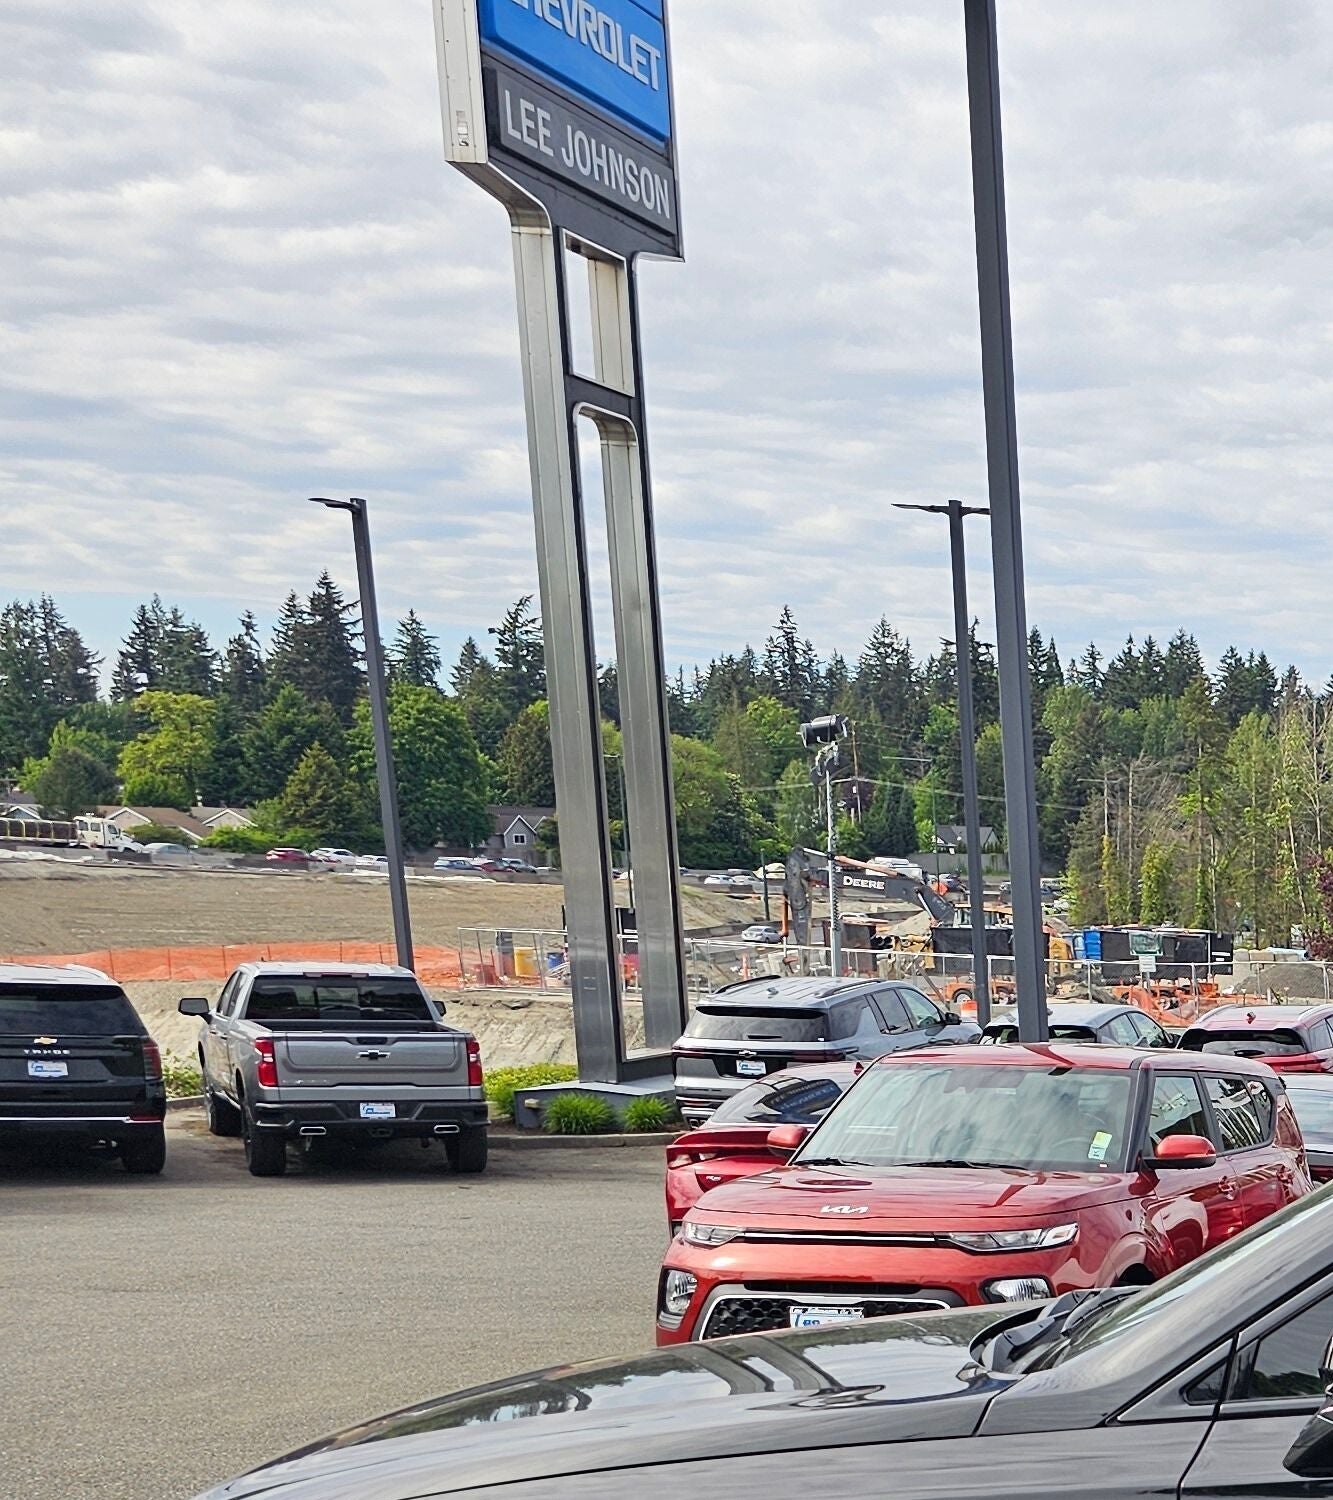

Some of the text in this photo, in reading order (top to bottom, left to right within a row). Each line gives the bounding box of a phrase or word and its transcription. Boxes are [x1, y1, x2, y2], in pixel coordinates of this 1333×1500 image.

[511, 0, 662, 91] EVROLET
[504, 89, 671, 219] LEE JOHNSON
